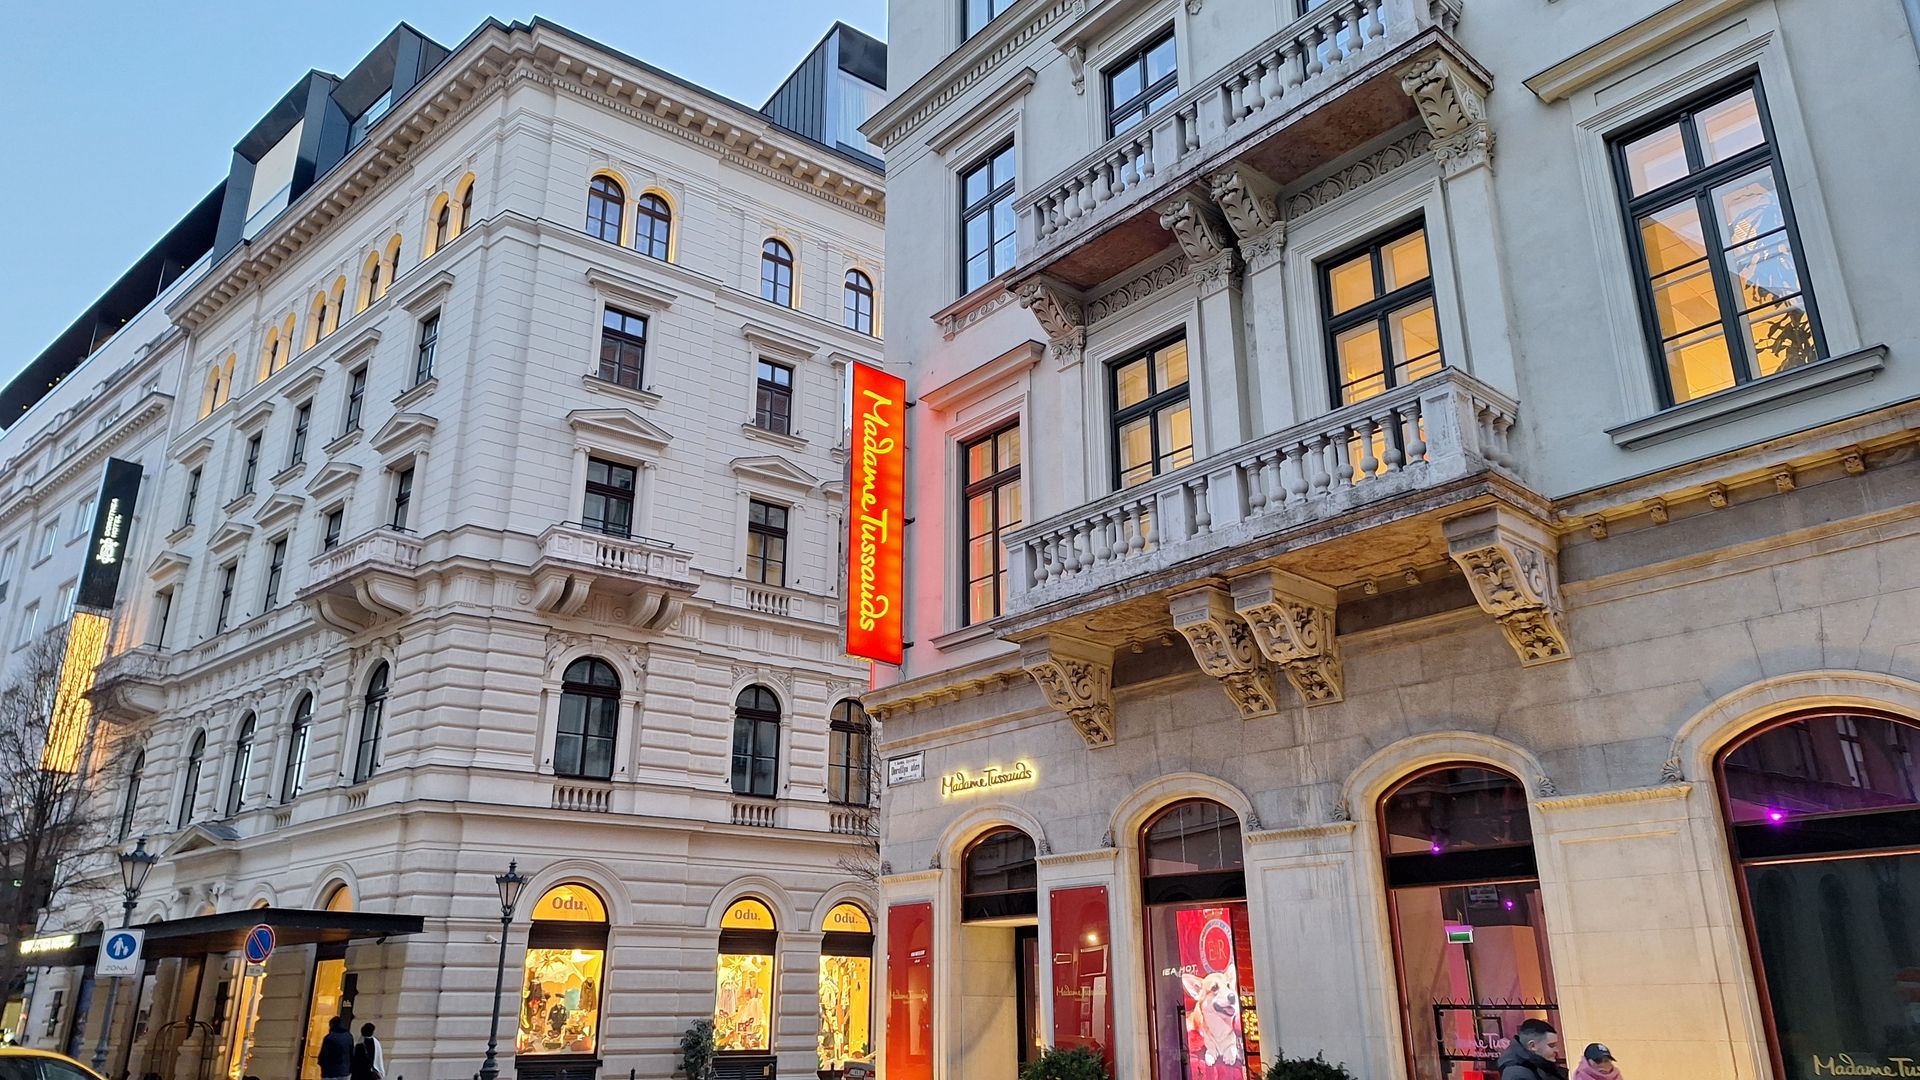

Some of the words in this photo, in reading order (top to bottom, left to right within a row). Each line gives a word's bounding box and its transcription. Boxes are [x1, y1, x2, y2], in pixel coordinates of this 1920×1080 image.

[860, 388, 894, 512] Madame
[858, 508, 889, 632] Tussauds
[941, 771, 987, 795] Madame
[983, 762, 1032, 787] Tussauds
[552, 896, 588, 912] Odu.
[734, 909, 761, 921] Odu.
[834, 913, 858, 924] Odu.
[1812, 1052, 1898, 1076] Madame
